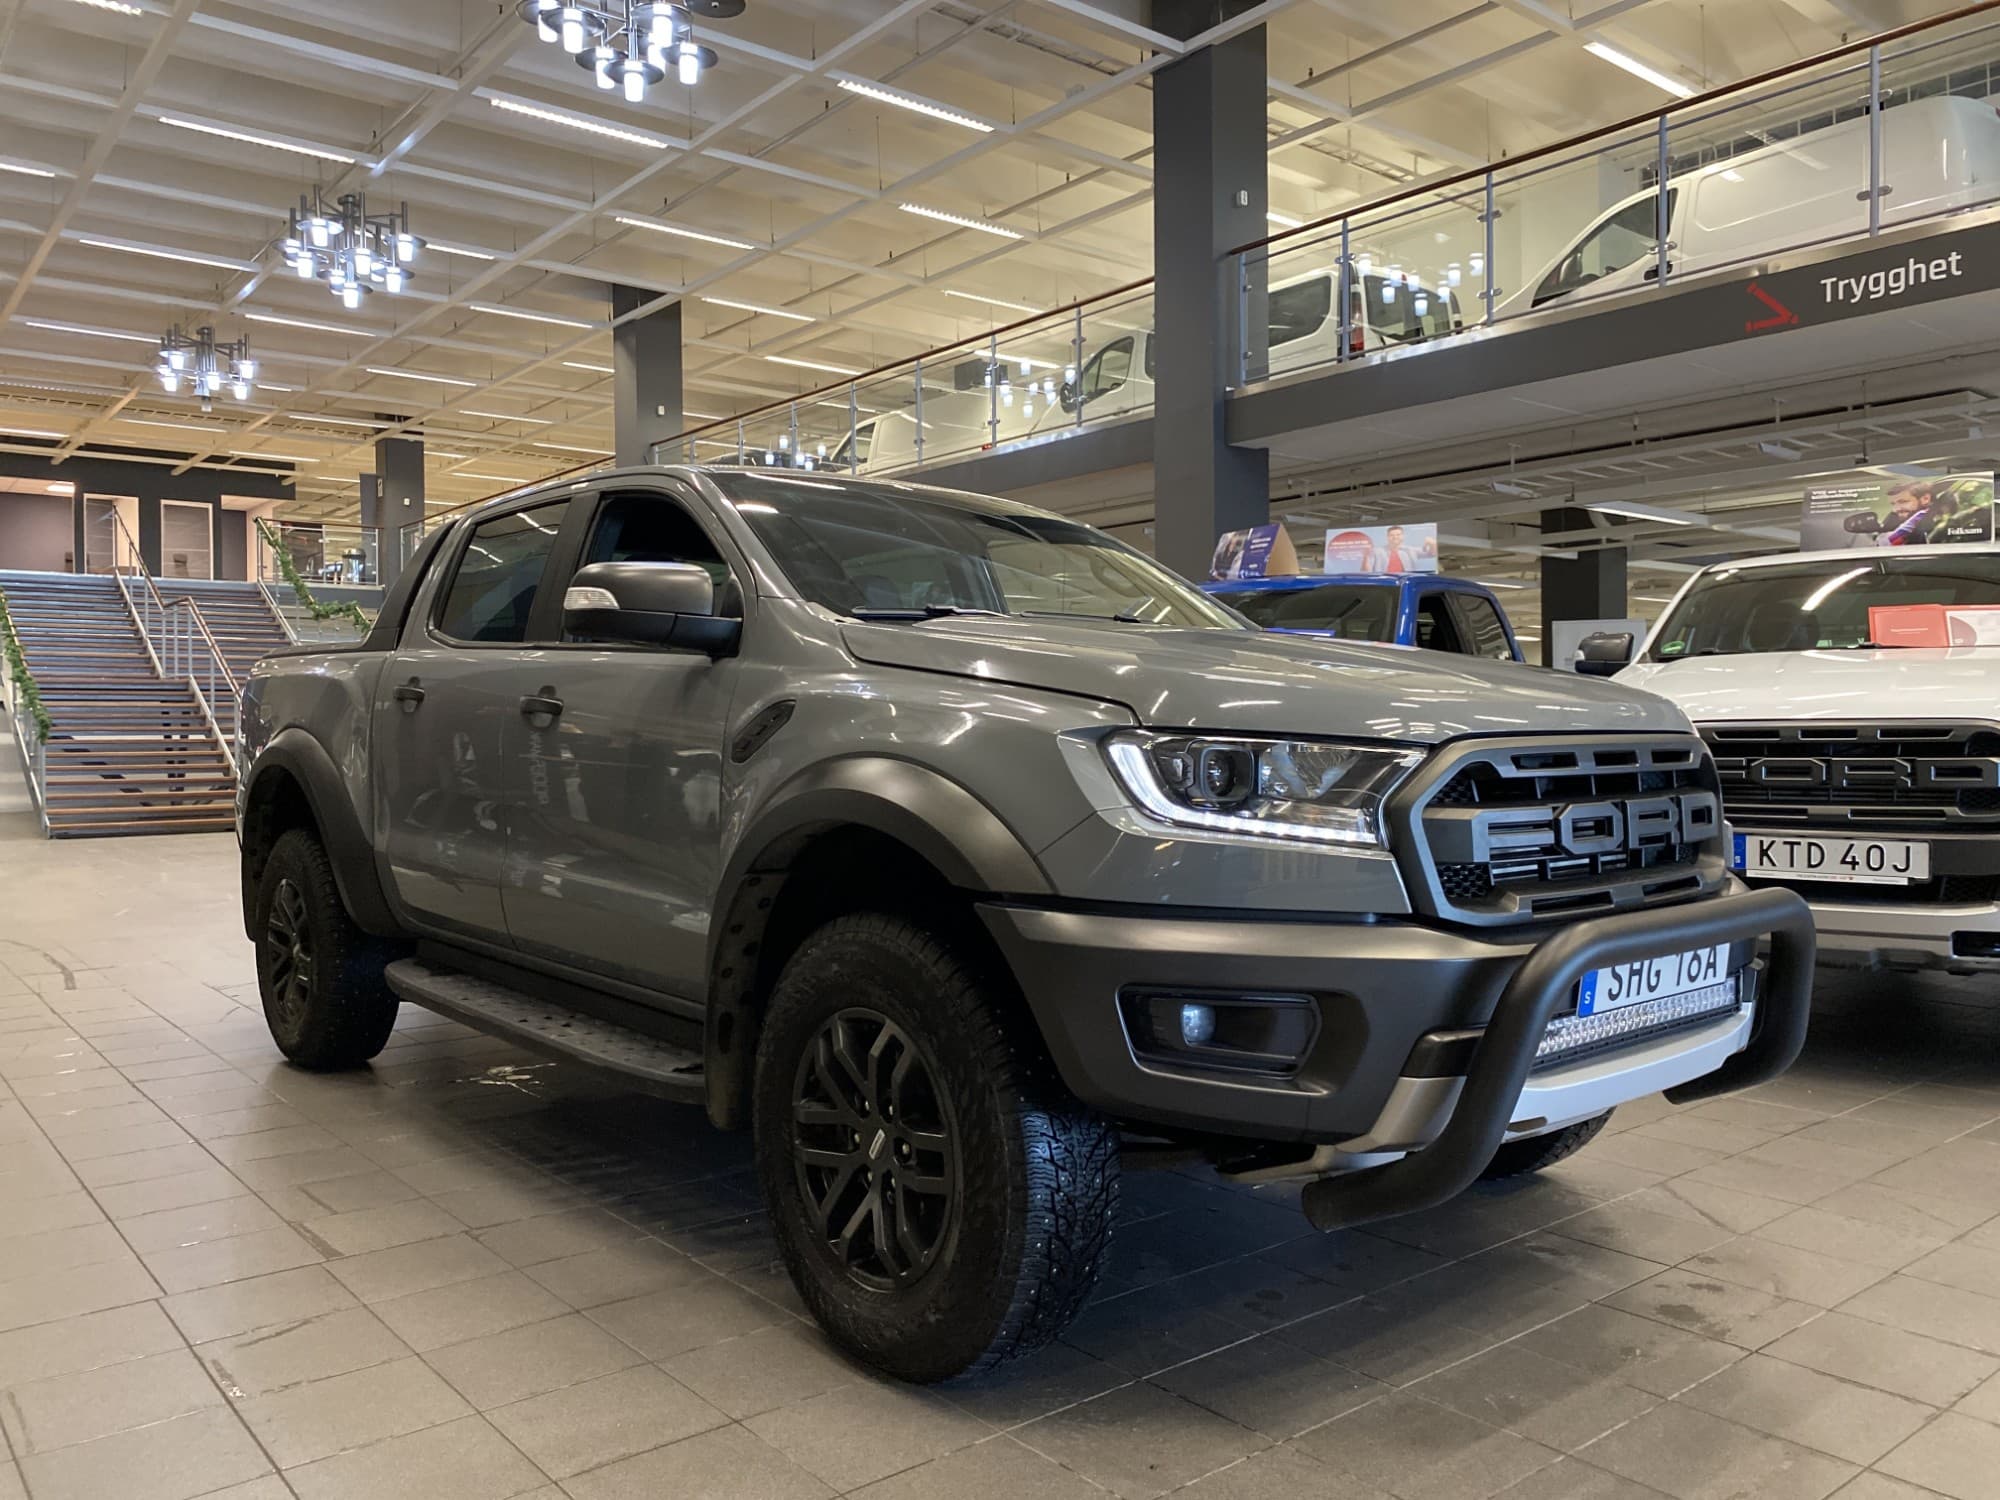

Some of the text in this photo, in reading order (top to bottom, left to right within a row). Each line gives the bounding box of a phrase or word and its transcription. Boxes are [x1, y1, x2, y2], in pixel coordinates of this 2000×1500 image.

[1820, 251, 1962, 303] Trygghet
[1471, 791, 1719, 863] FORD
[1759, 839, 1911, 873] KTD 40J
[1584, 991, 1592, 1004] S
[1608, 959, 1661, 1002] SHG
